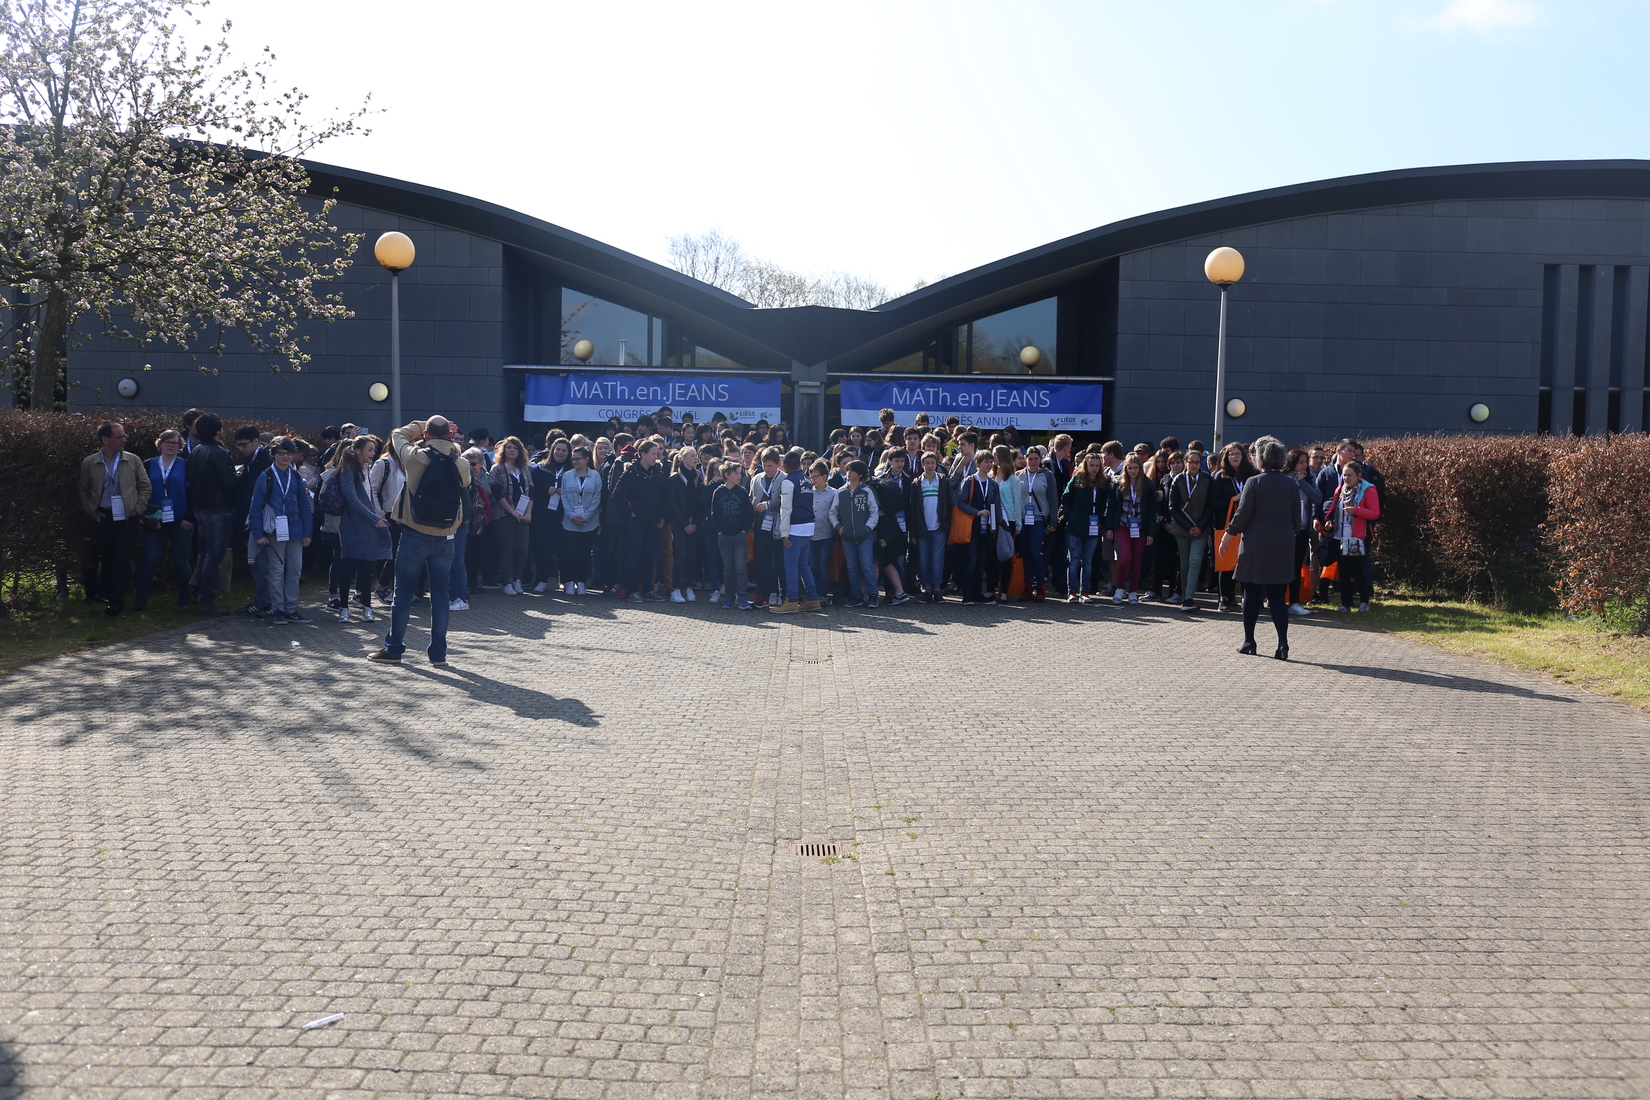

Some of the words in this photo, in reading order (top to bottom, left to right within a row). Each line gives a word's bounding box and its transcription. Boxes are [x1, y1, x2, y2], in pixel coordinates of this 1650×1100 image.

[570, 381, 730, 404] MATh.en.JEANS
[892, 387, 1051, 411] MATh.en.JEANS
[976, 416, 1021, 426] ANNUEL
[855, 503, 865, 512] 74
